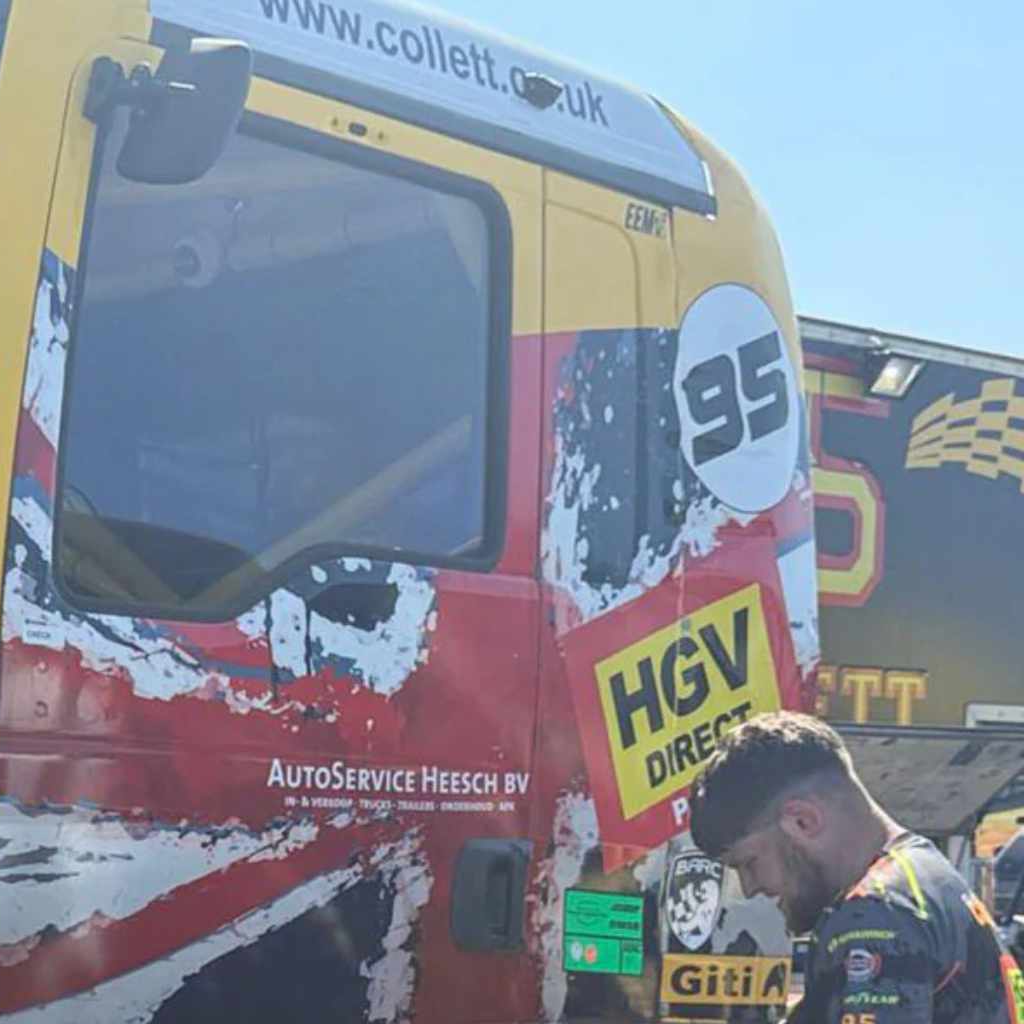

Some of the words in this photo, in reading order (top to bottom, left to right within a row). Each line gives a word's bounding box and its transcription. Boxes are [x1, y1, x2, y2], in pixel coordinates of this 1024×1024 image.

[257, 0, 609, 127] www.collett.c.uk
[681, 330, 790, 466] 95
[608, 606, 749, 751] HGV
[421, 765, 498, 795] HEESCH
[504, 771, 530, 795] BV
